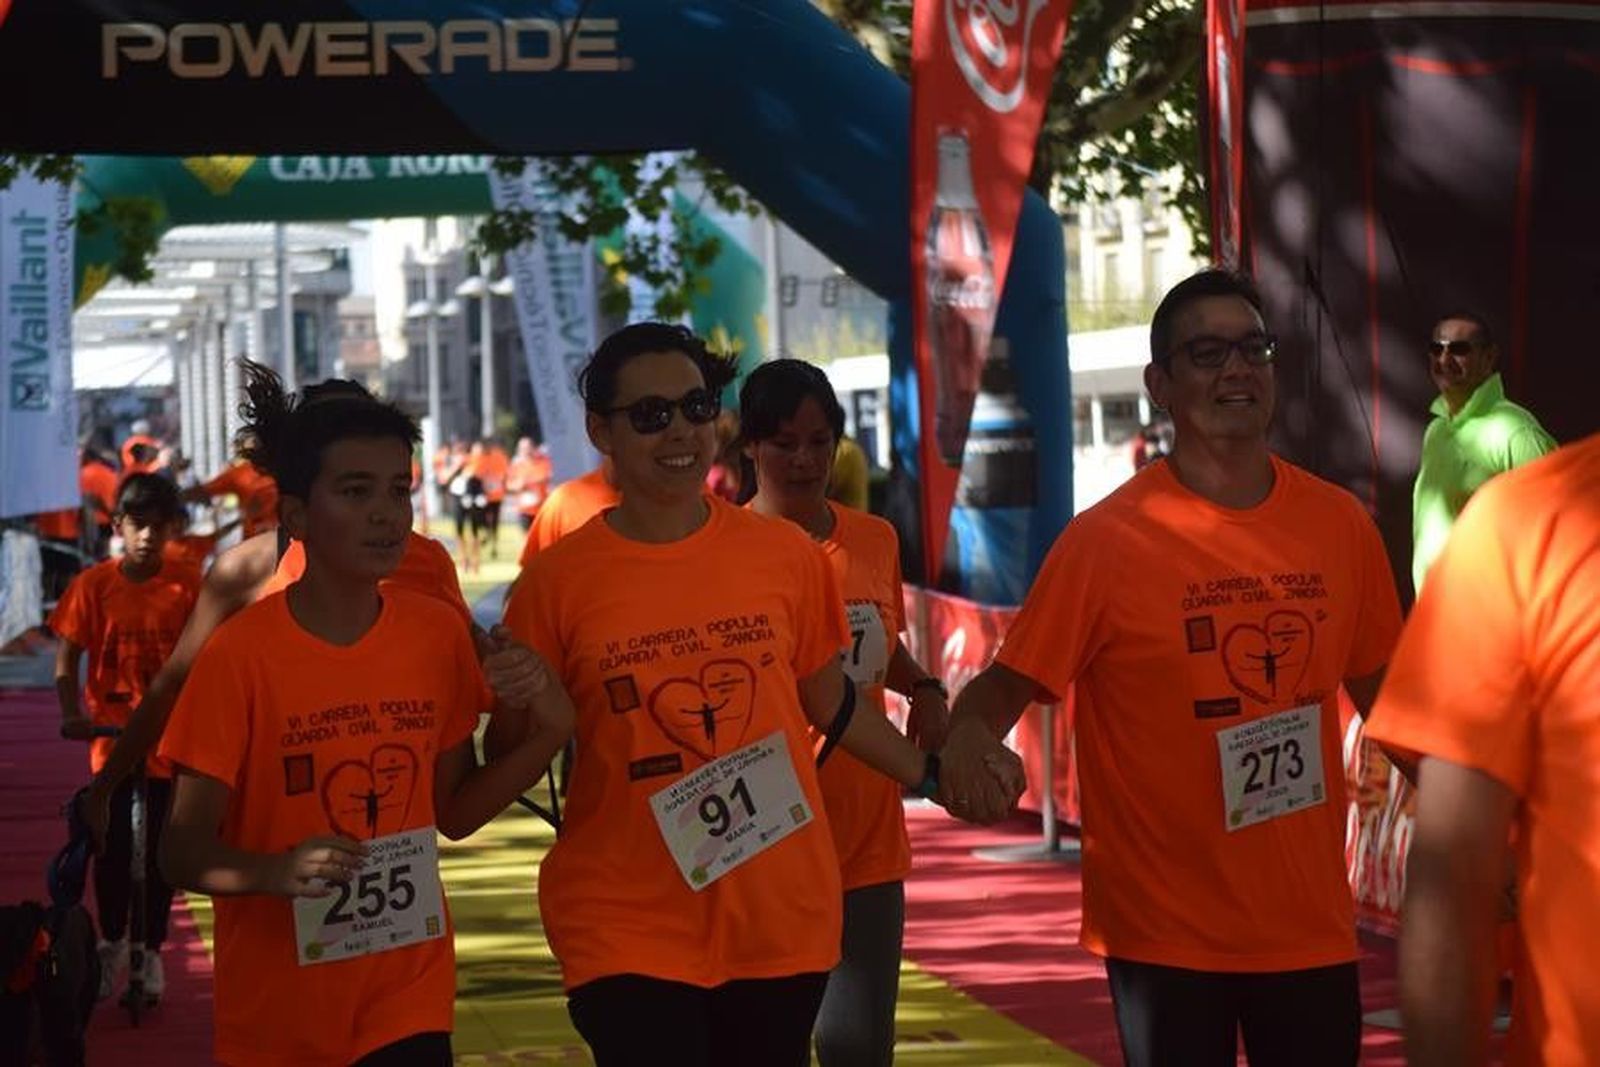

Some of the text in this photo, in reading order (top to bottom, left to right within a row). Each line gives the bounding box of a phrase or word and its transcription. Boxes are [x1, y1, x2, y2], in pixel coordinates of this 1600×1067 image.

[101, 17, 620, 79] POWERADE
[9, 210, 50, 372] Vaillant
[598, 629, 776, 672] GUARDIA CIVIL ZAMORA
[628, 627, 698, 649] CARRERA
[706, 613, 769, 636] POPULAR
[281, 725, 340, 748] GUARDIA
[308, 702, 371, 726] CARRERA
[1241, 738, 1304, 795] 273
[698, 776, 757, 838] 91
[323, 863, 416, 927] 255
